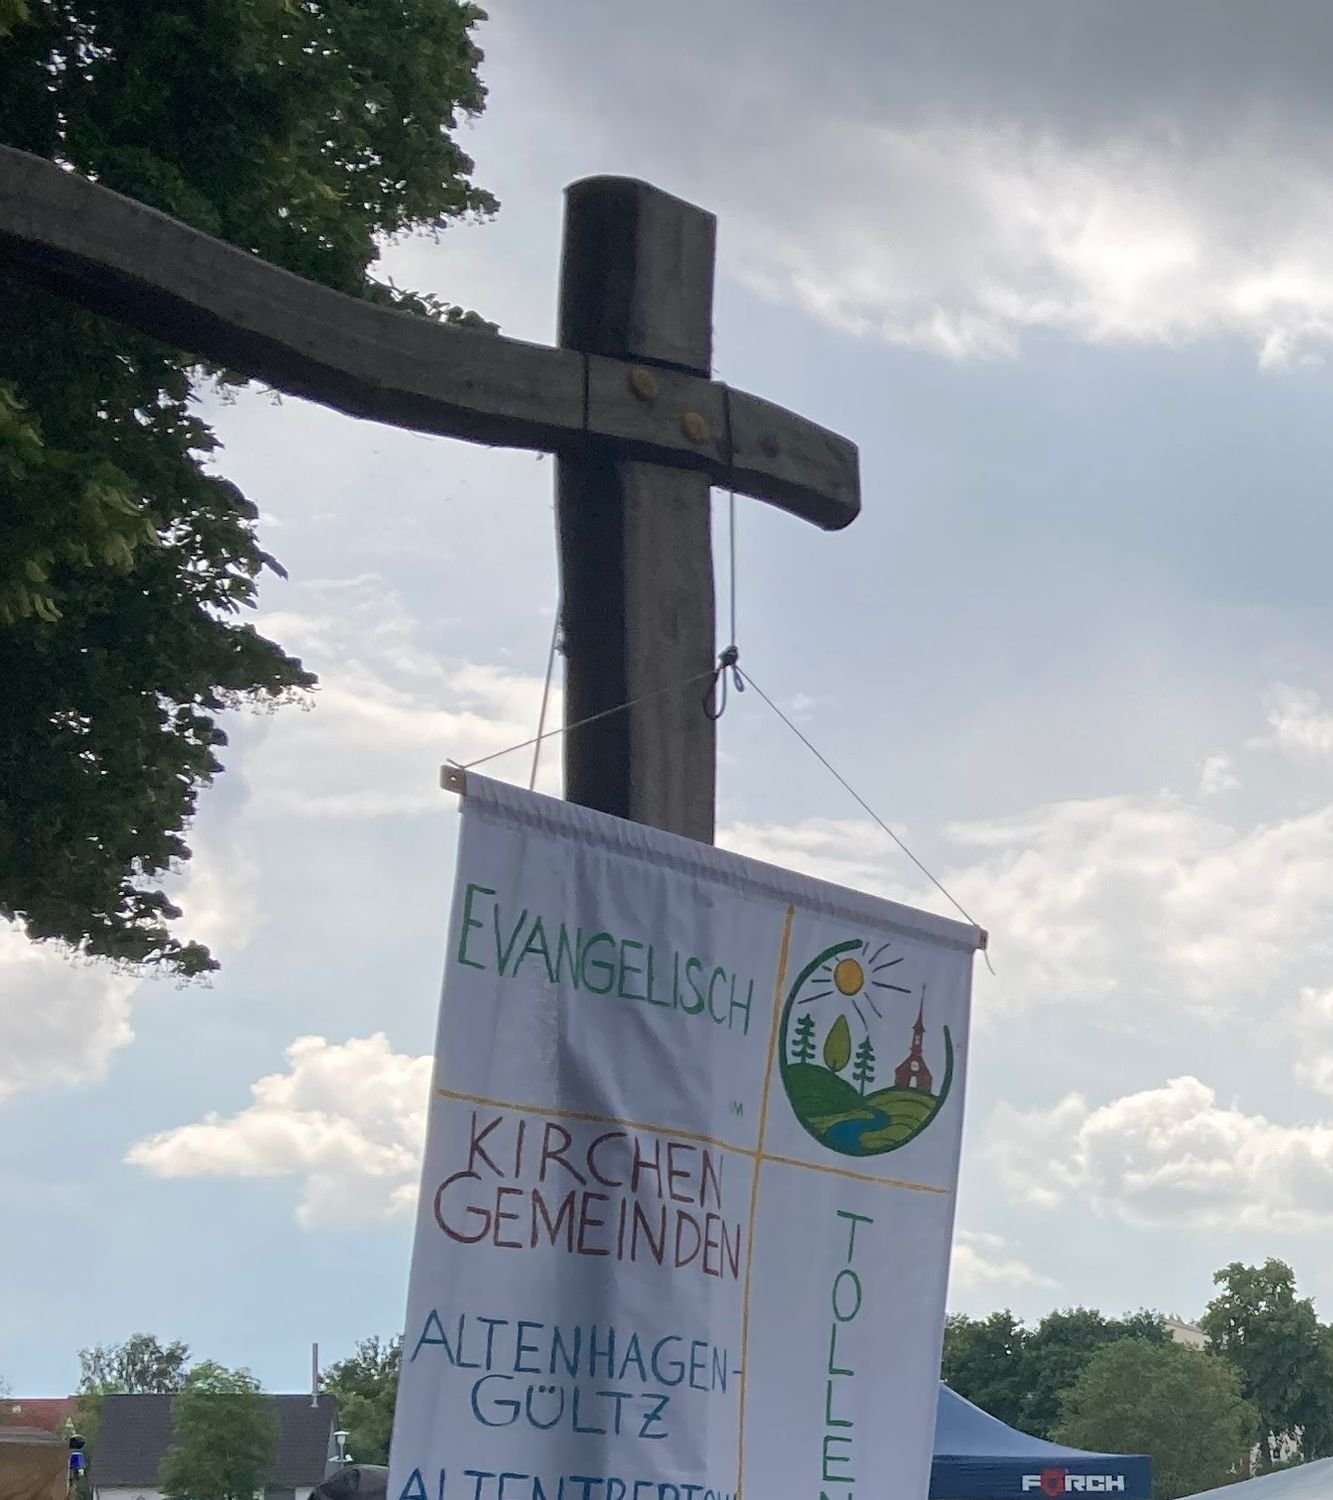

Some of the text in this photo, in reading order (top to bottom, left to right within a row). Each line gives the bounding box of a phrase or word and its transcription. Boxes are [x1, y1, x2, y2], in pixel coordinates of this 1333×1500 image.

[457, 883, 754, 1036] EVANGELISCH
[466, 1111, 723, 1208] KIRCHEN
[433, 1170, 742, 1281] GEMEINDEN
[411, 1309, 744, 1394] ALTENHAGEN-
[471, 1374, 671, 1440] GÜLTZ
